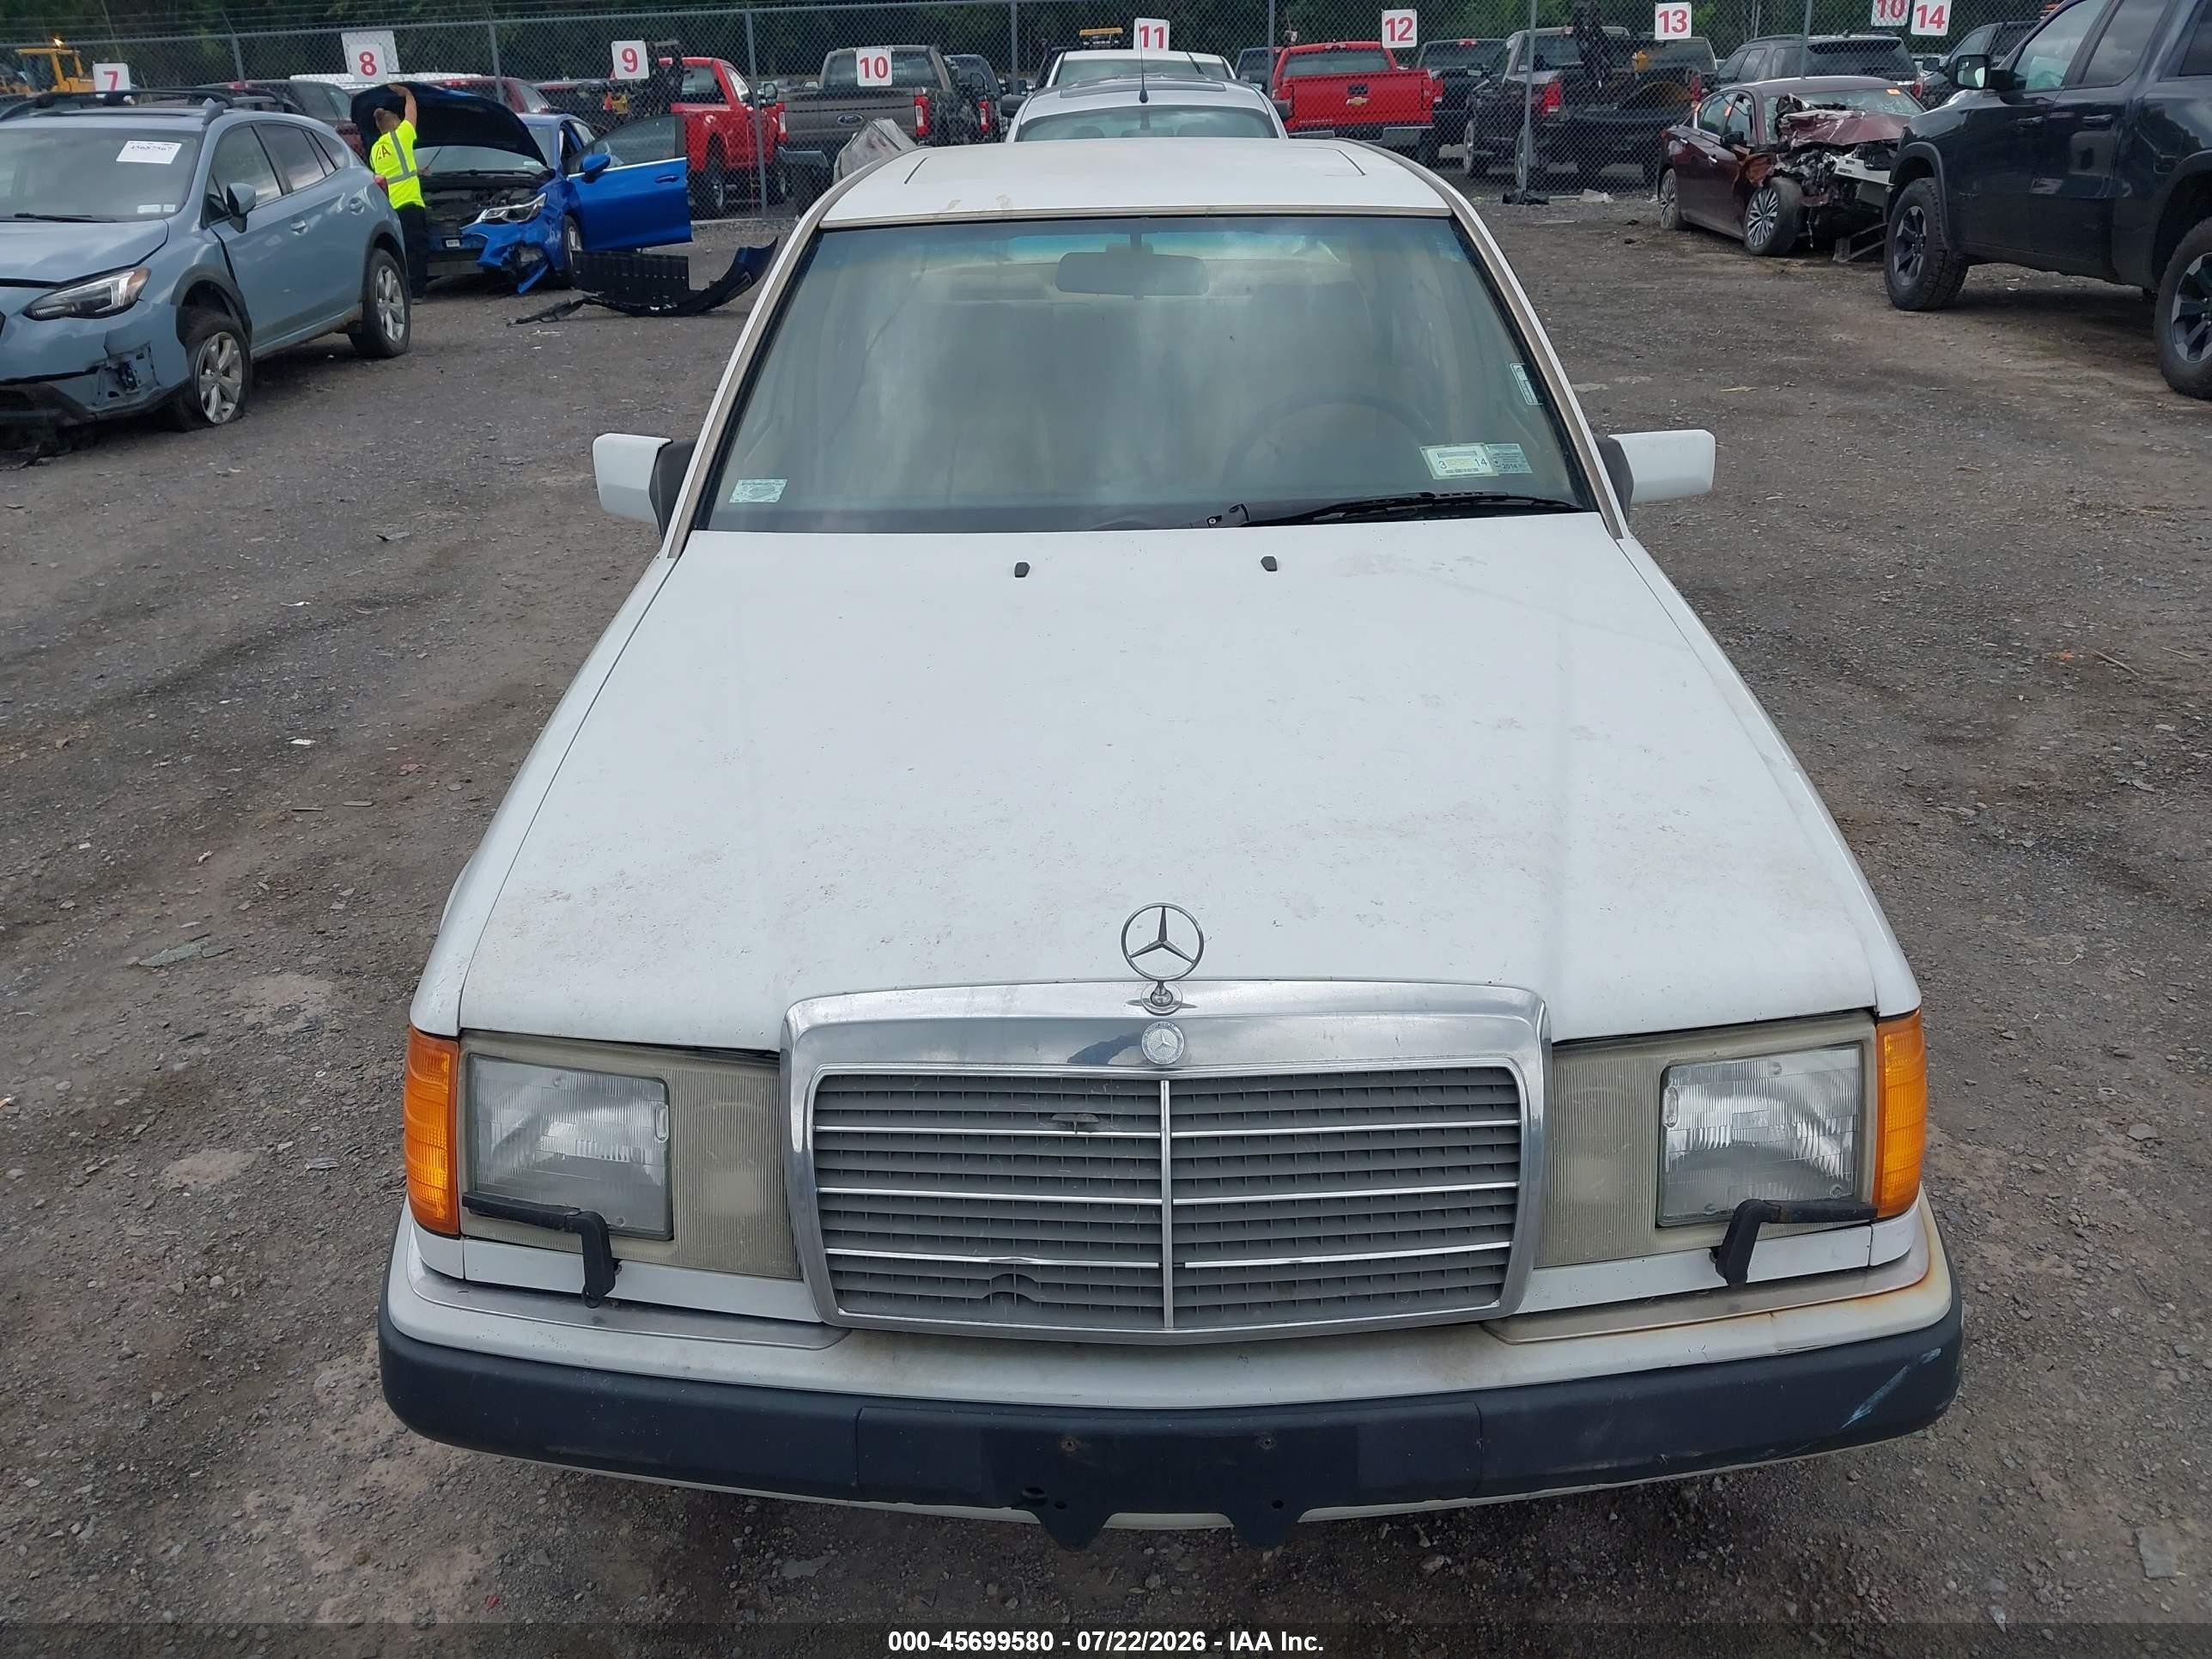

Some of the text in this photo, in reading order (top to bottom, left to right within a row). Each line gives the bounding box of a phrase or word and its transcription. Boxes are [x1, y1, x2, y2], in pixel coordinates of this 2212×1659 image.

[1658, 9, 1687, 33] 13
[1917, 4, 1945, 28] 14
[1139, 26, 1164, 49] 11
[1385, 17, 1413, 41] 12
[359, 51, 377, 76] 8
[622, 47, 638, 73] 9
[860, 56, 889, 79] 10
[103, 70, 118, 91] 7
[1474, 458, 1488, 467] 14
